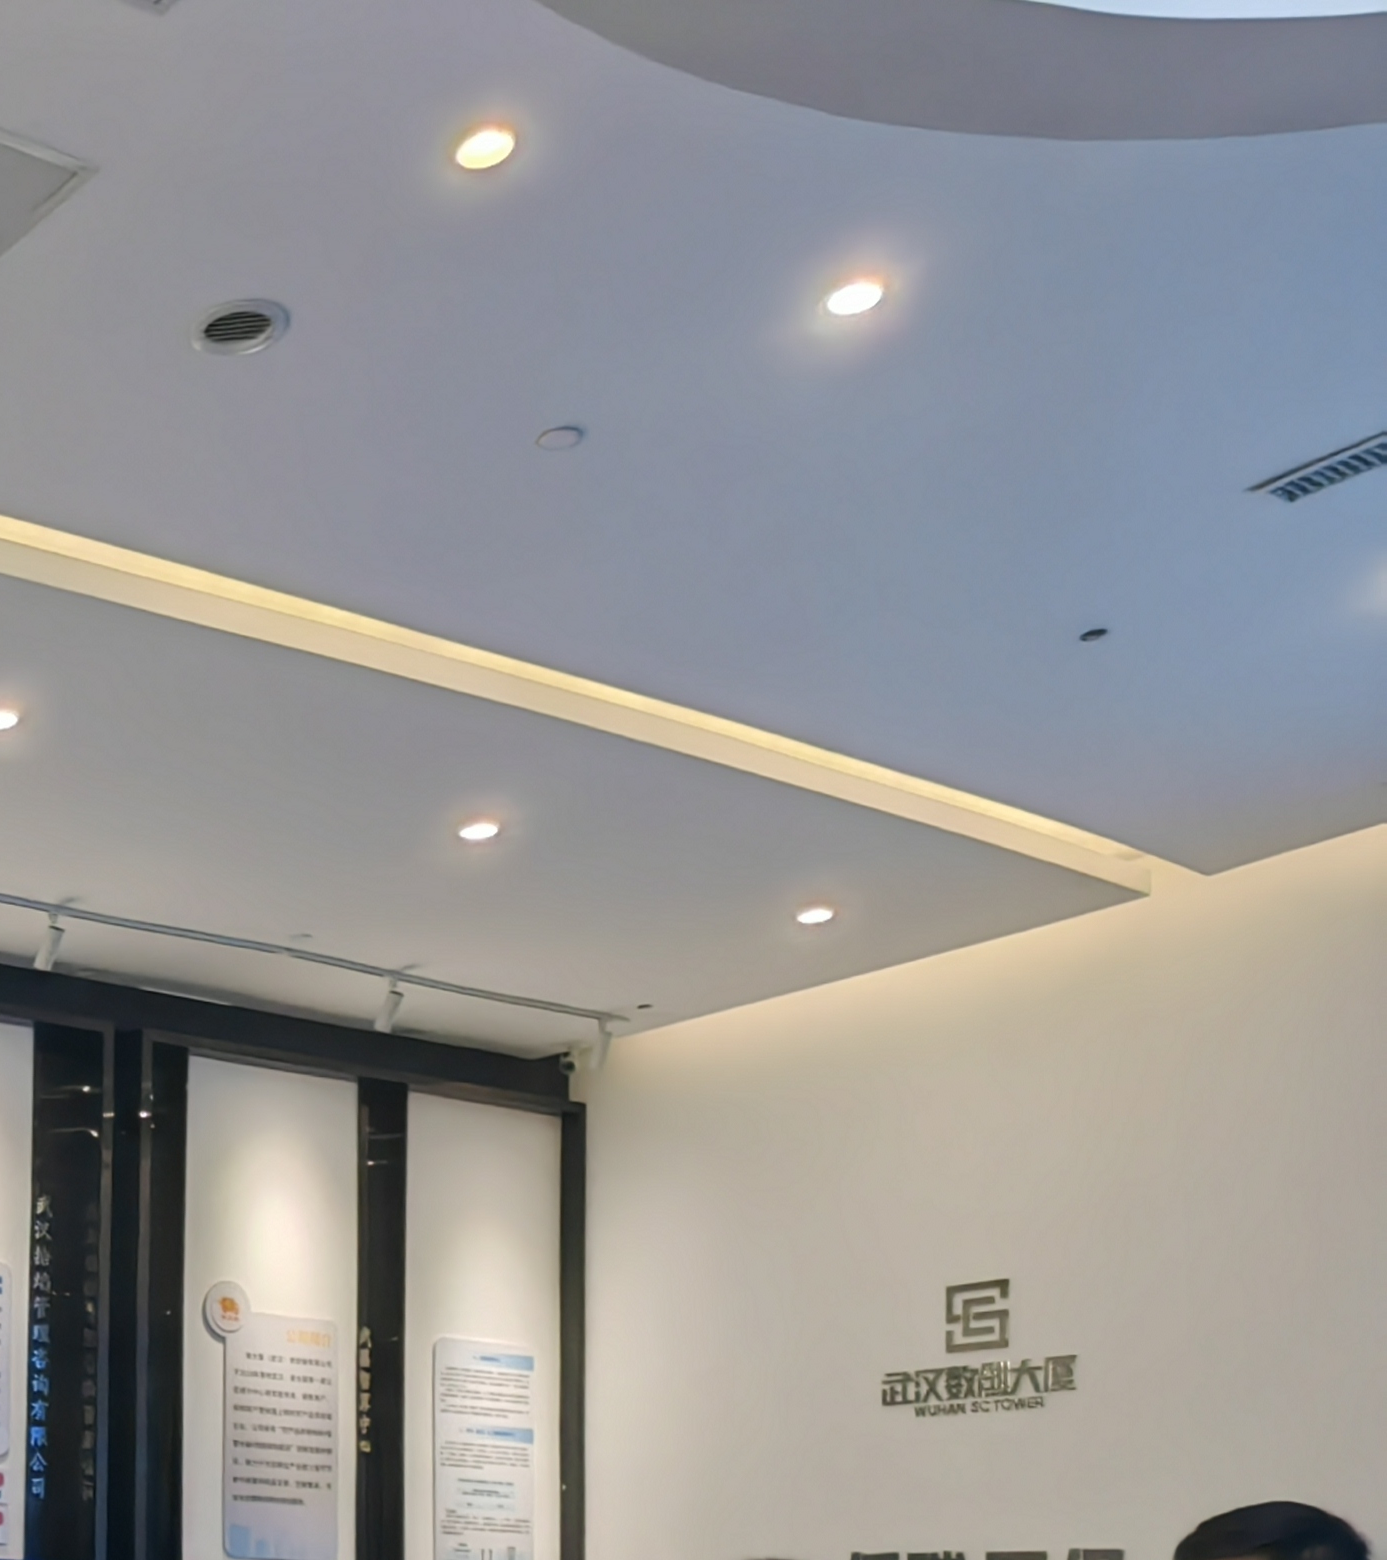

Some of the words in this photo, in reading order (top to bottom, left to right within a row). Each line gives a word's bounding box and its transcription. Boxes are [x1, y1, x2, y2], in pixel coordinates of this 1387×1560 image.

[882, 1355, 1077, 1406] 武汉数创大厦
[915, 1403, 966, 1418] WUHAN
[971, 1400, 991, 1413] SC
[993, 1396, 1044, 1411] TOWER
